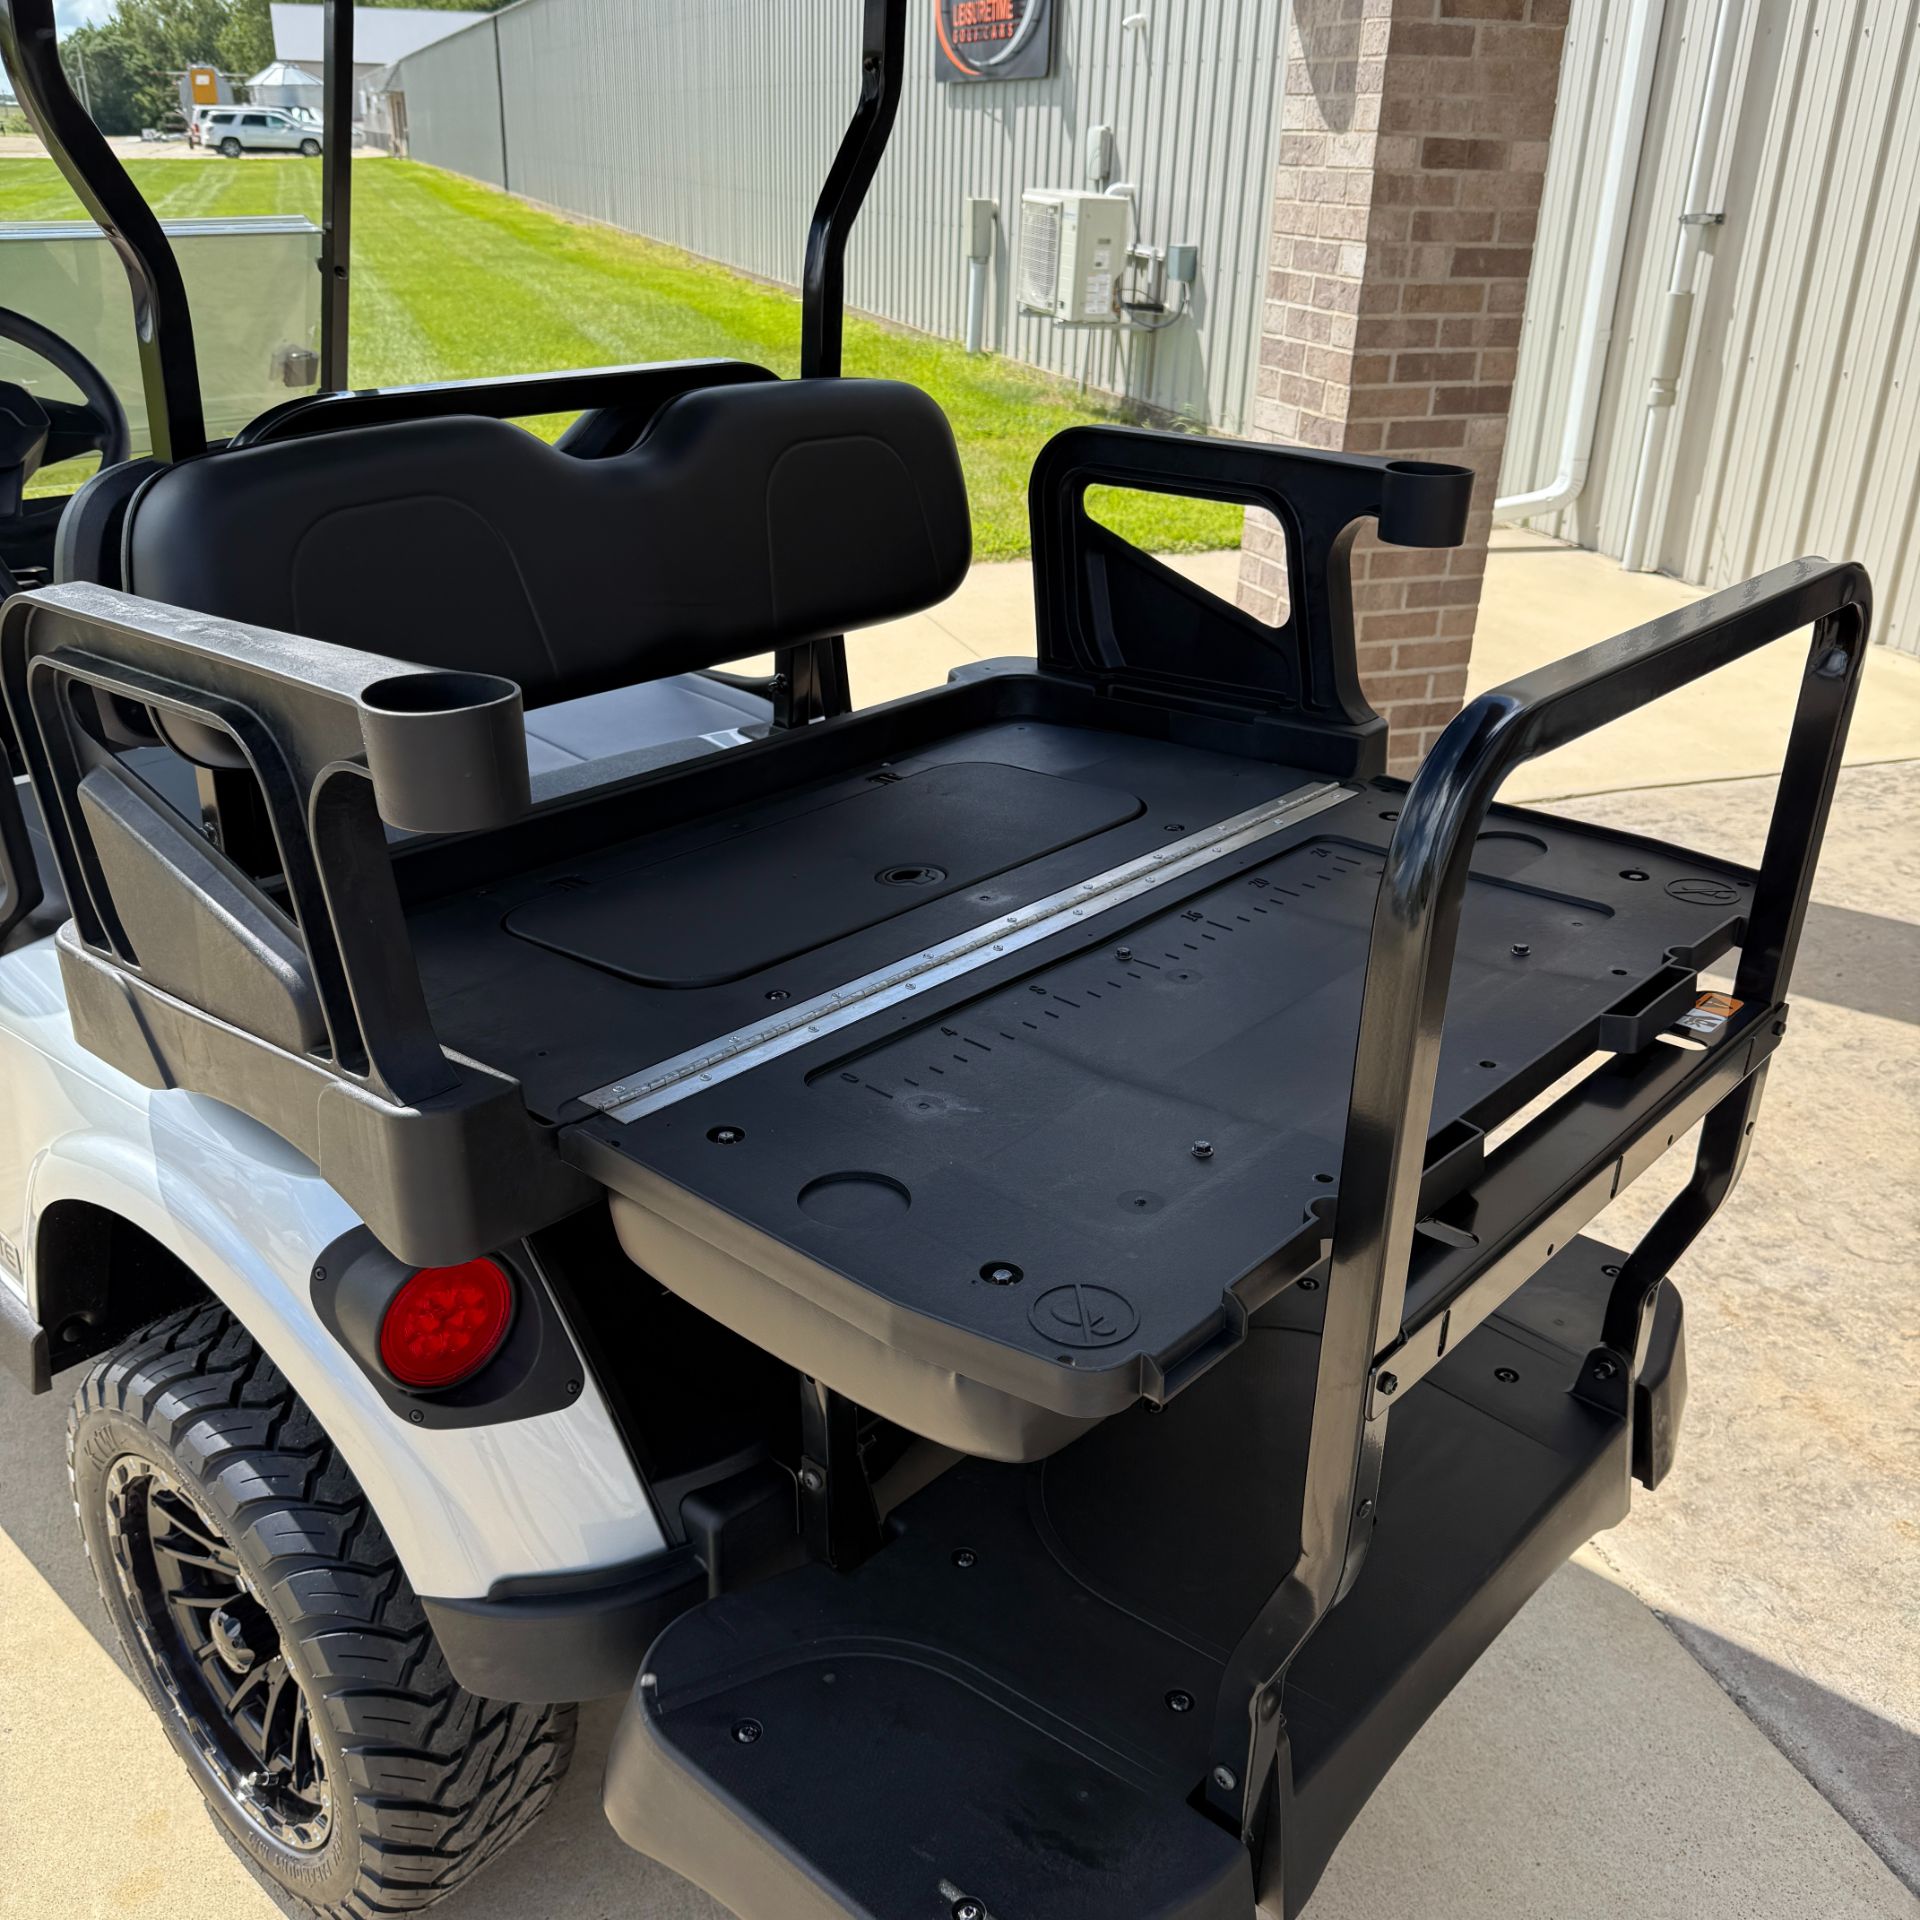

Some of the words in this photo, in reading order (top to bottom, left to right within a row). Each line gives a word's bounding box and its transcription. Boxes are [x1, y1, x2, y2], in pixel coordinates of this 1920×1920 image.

[941, 1026, 958, 1036] 4
[1029, 985, 1047, 995] 8
[1181, 910, 1204, 922] 16
[1248, 878, 1270, 888] 20
[1310, 848, 1332, 858] 24
